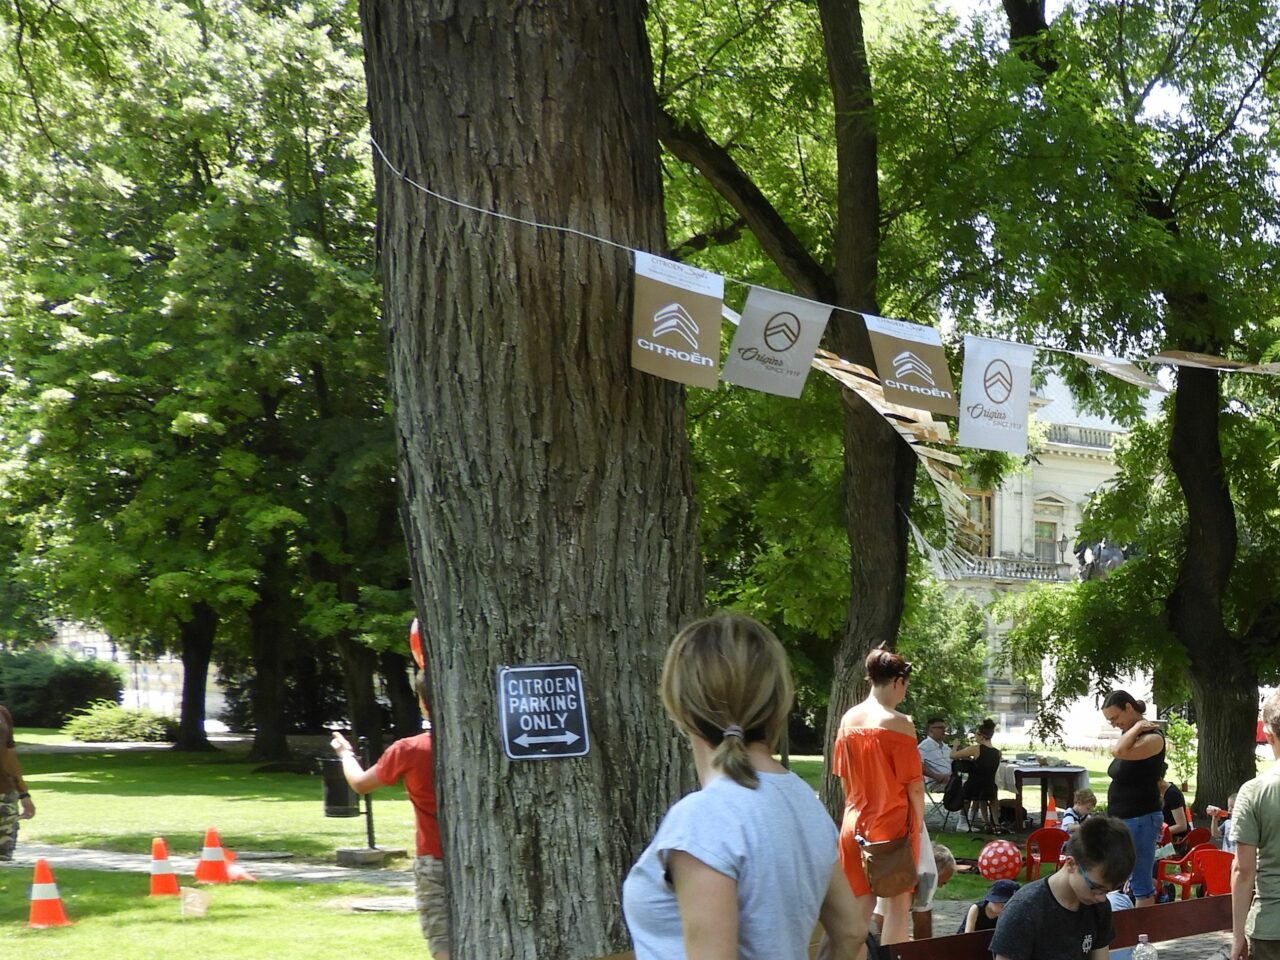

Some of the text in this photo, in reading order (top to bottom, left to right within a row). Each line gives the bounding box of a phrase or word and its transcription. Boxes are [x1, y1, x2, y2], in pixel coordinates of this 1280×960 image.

[738, 347, 784, 367] Origins
[967, 403, 1007, 421] Origins
[508, 677, 577, 696] CITROEN
[509, 695, 578, 713] PARKING
[520, 713, 568, 731] ONLY
